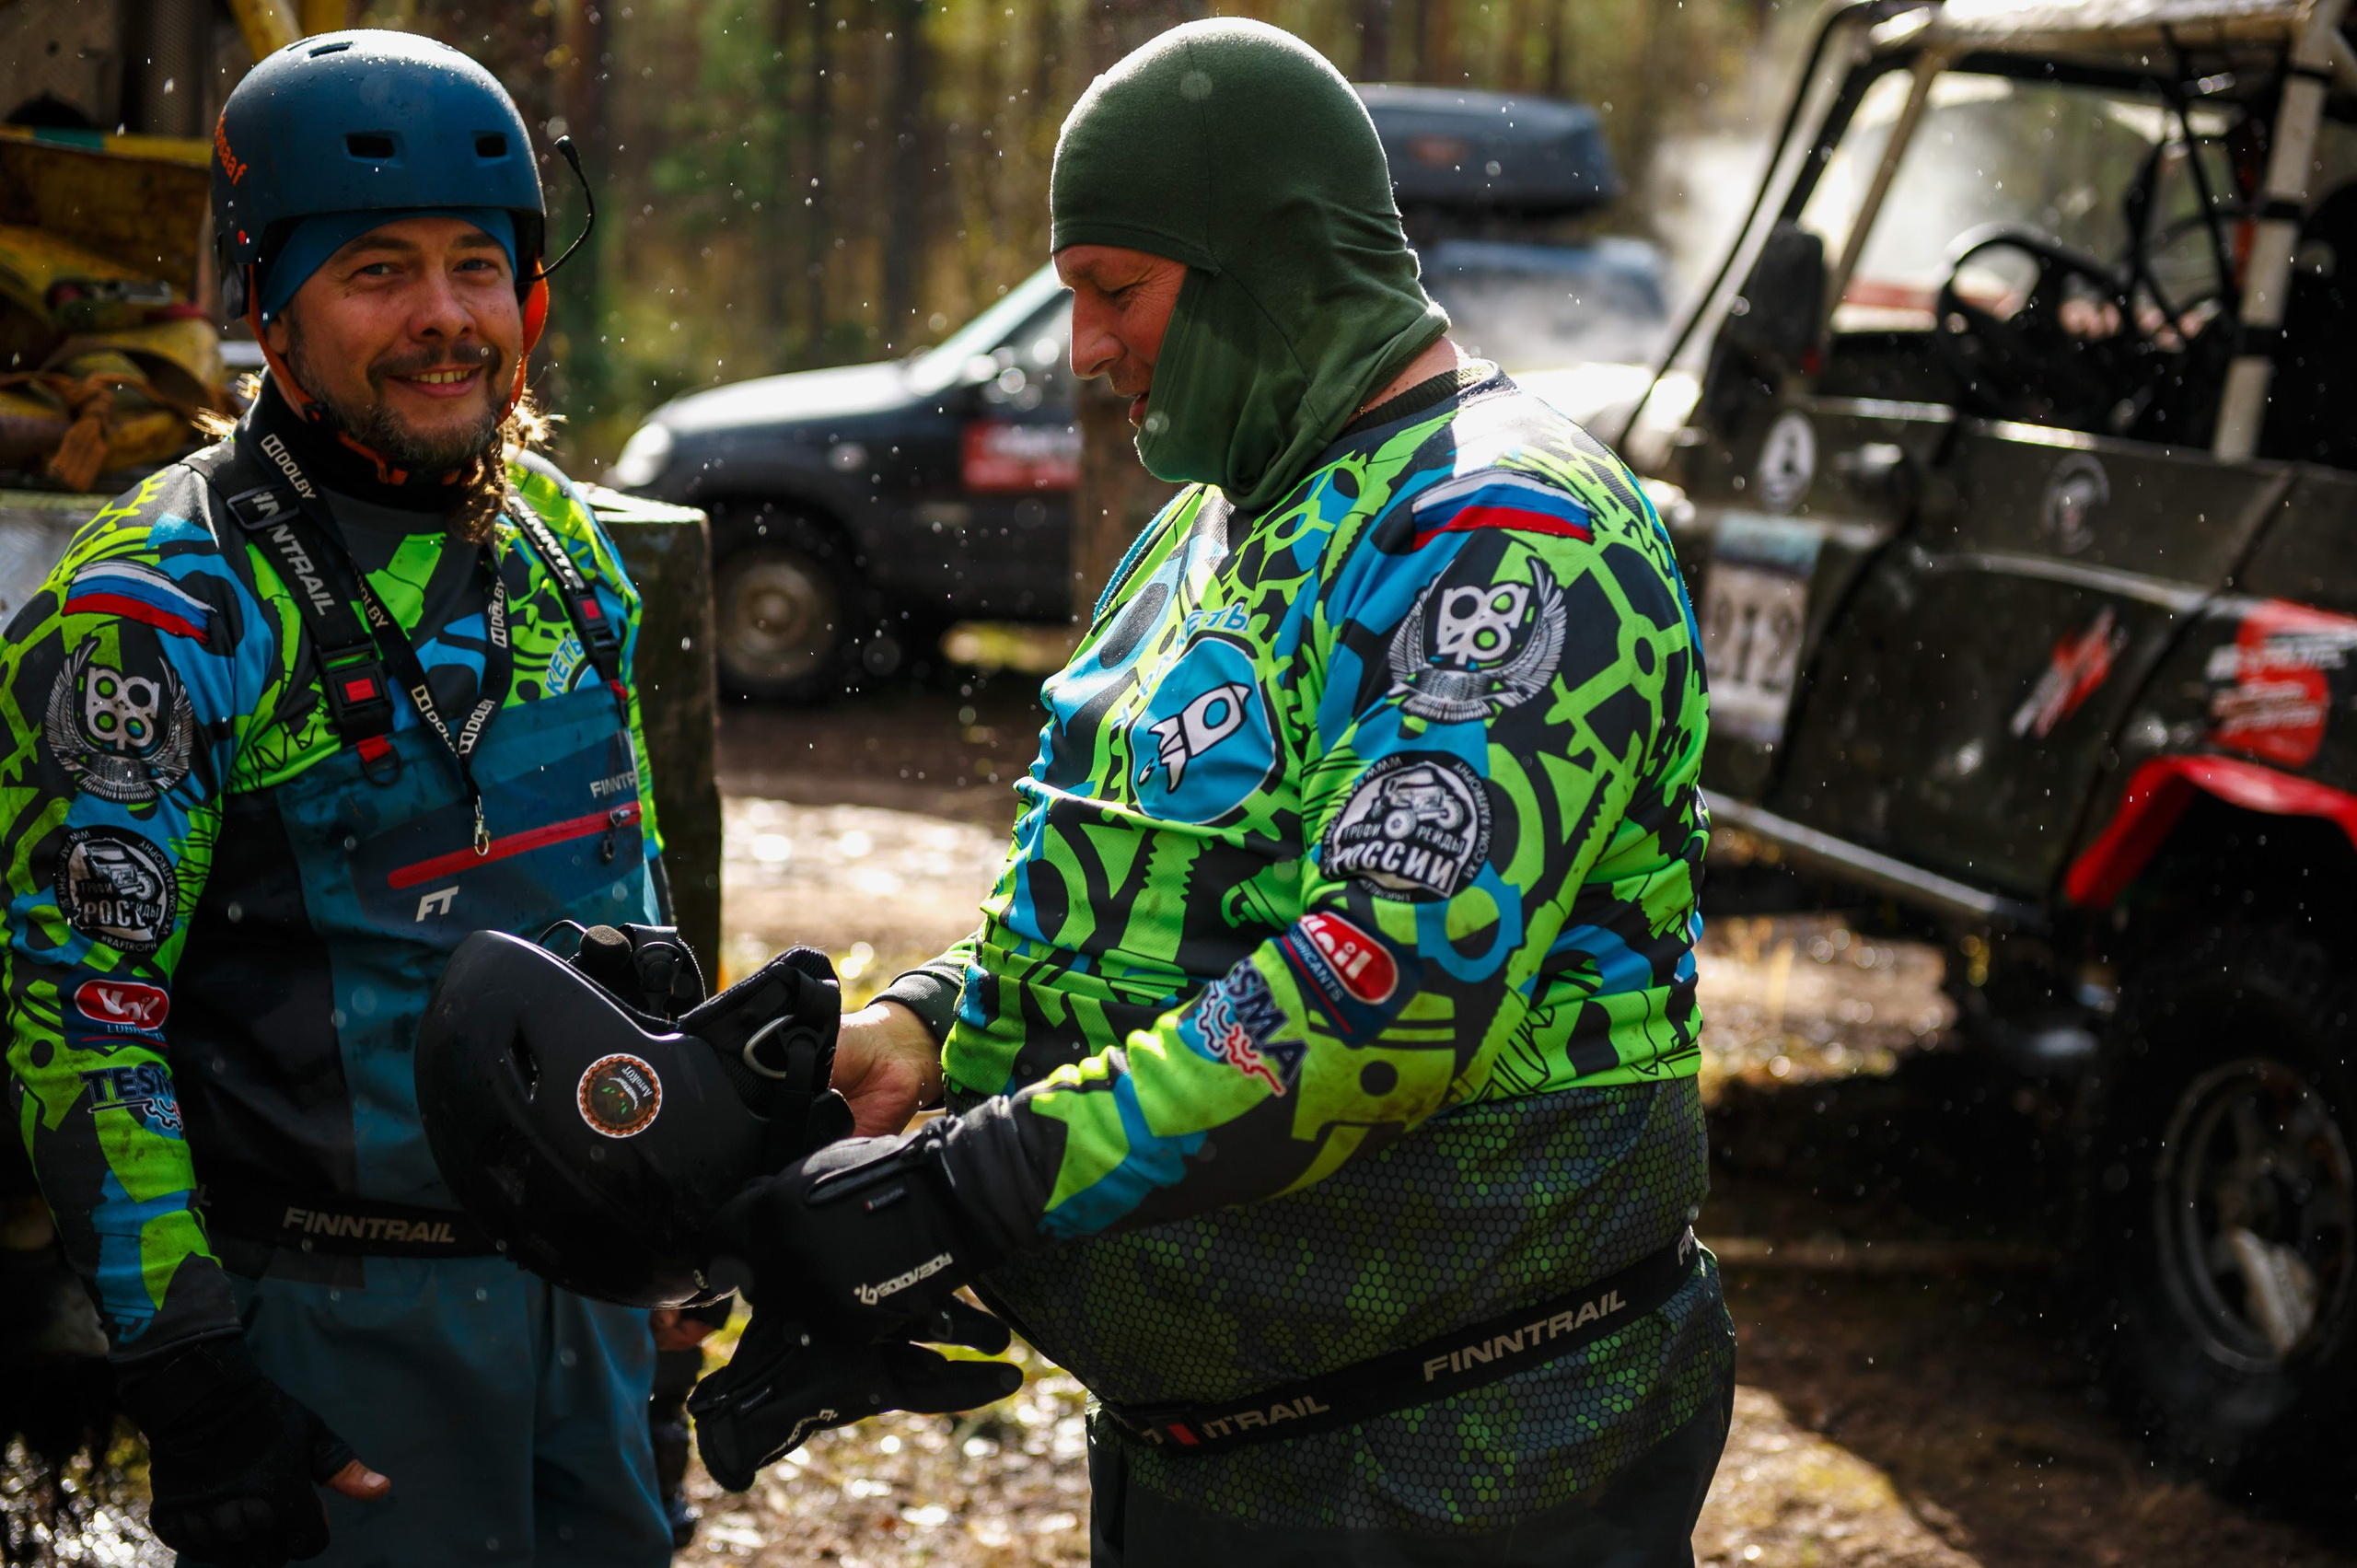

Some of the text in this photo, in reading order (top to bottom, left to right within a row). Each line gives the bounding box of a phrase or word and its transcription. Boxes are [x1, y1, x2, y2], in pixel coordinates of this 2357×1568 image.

[275, 451, 317, 500] DOLBY
[492, 575, 505, 629] DOLBY
[465, 698, 496, 732] DOLBY
[415, 885, 459, 923] FT
[282, 1205, 457, 1244] FINNTRAIL
[1422, 1289, 1627, 1383] FINNTRAIL
